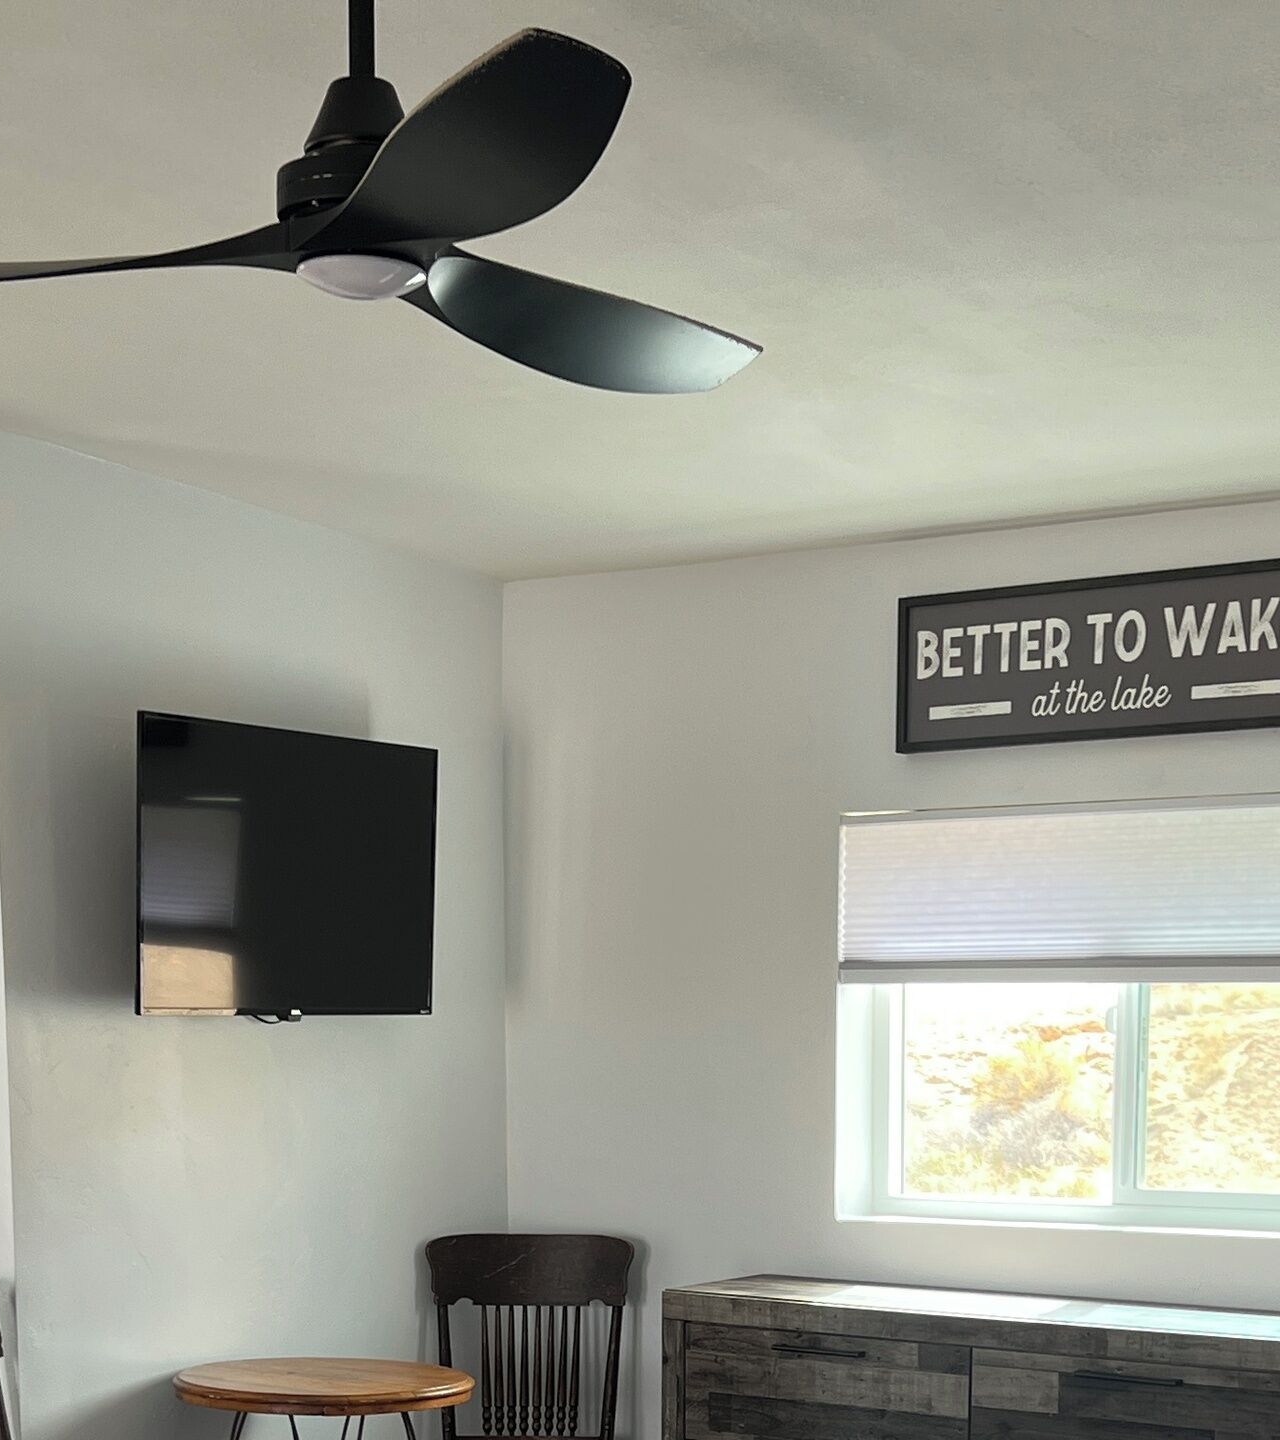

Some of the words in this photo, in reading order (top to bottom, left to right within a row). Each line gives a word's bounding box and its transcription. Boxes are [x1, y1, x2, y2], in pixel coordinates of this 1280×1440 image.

[916, 617, 1071, 680] BETTER
[1086, 609, 1147, 665] TO
[1031, 681, 1061, 717] at
[1065, 679, 1106, 714] the
[1110, 673, 1172, 711] lake
